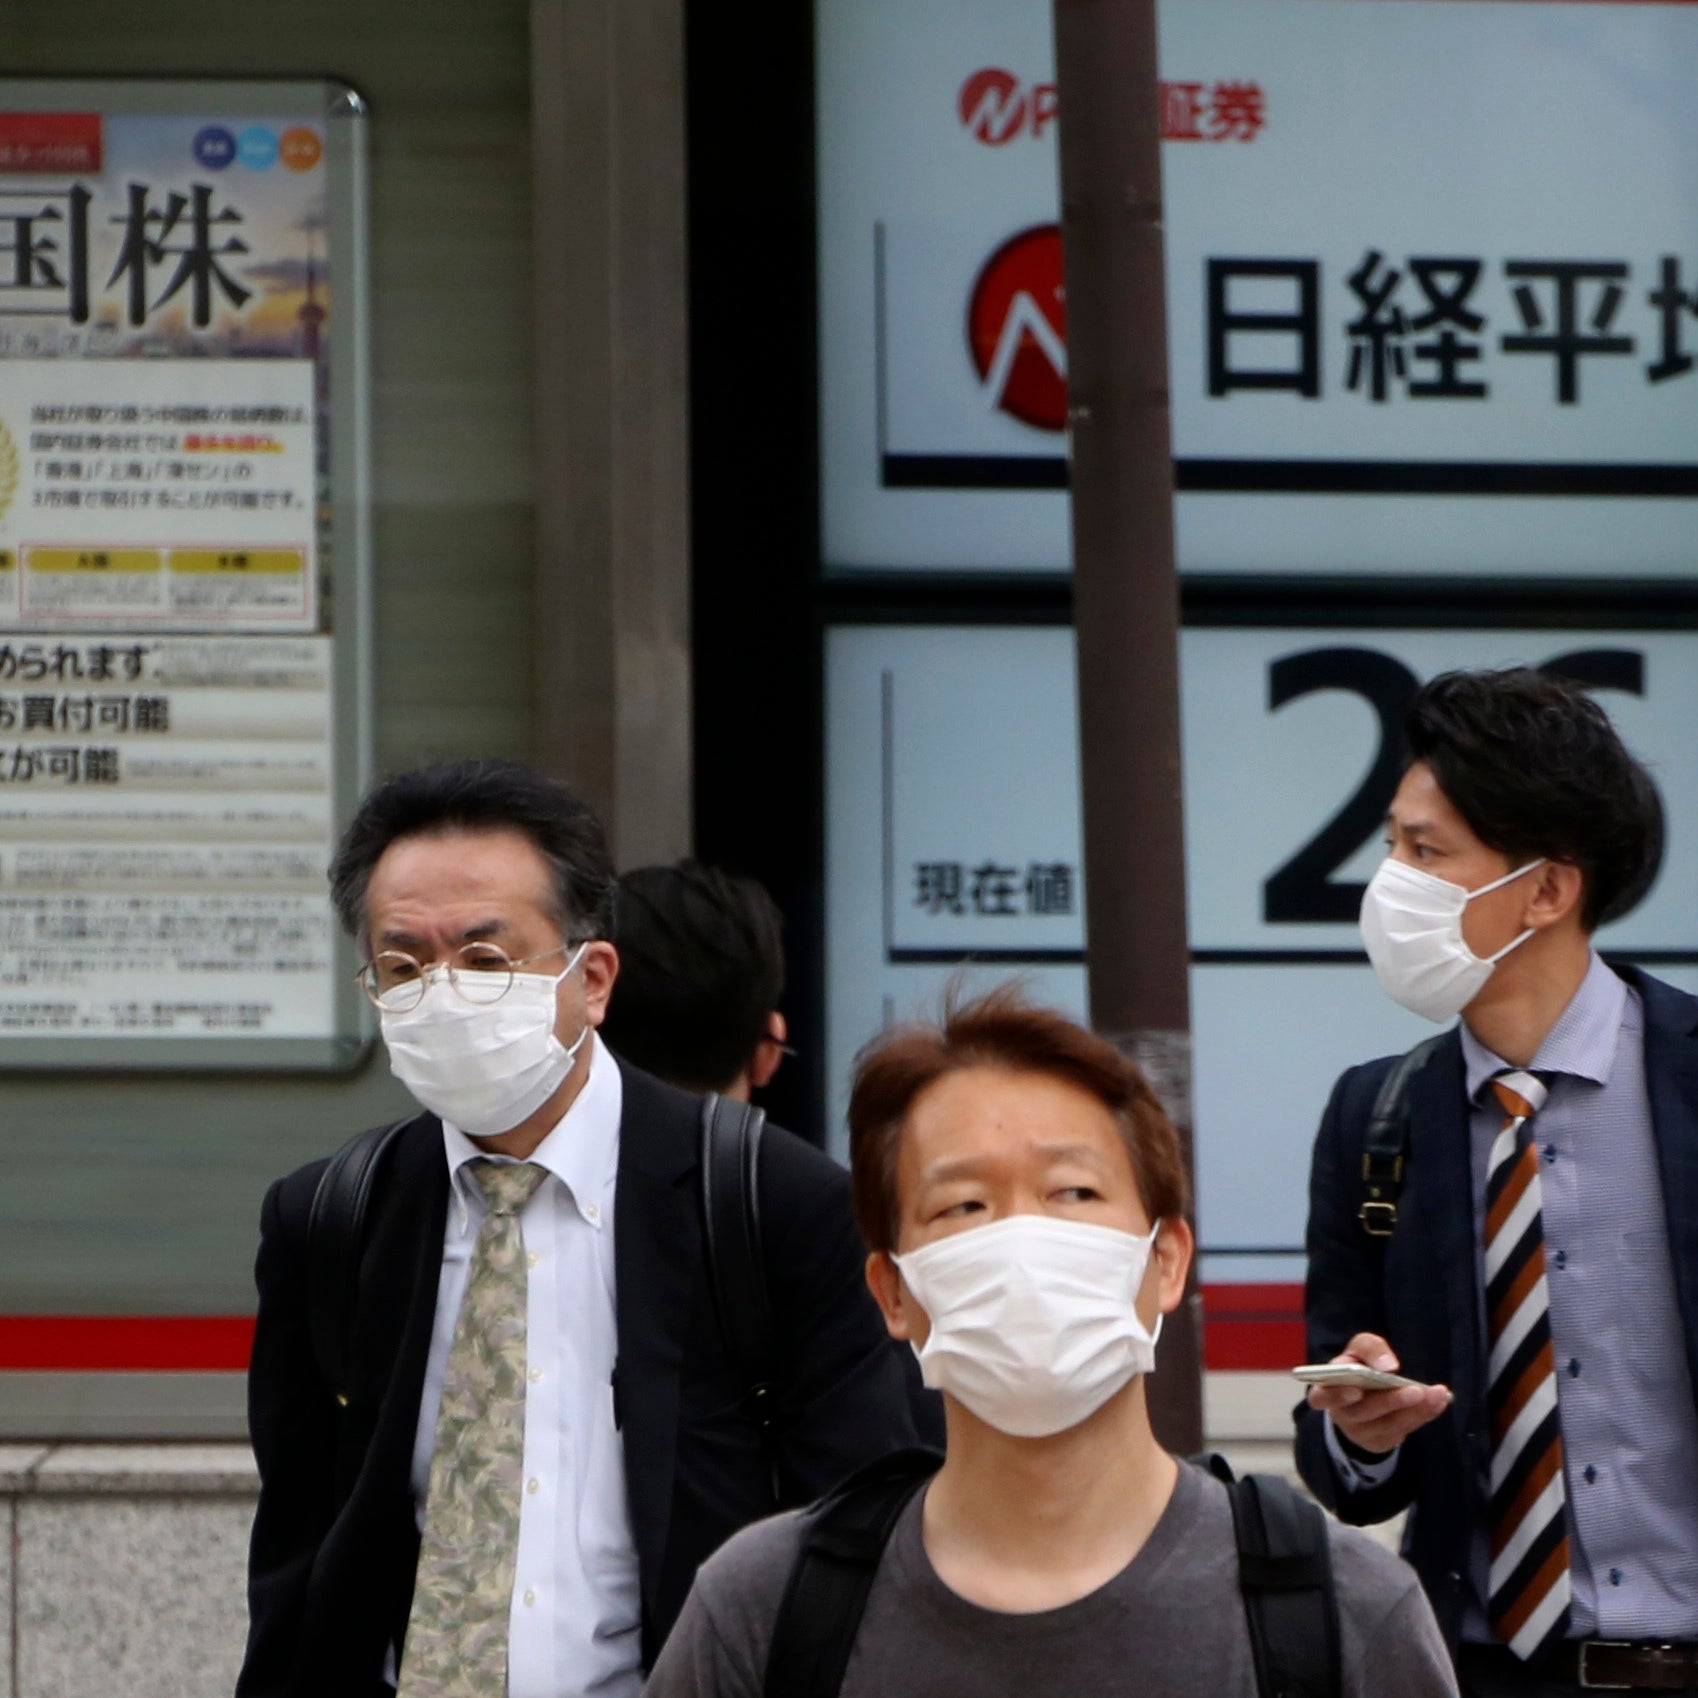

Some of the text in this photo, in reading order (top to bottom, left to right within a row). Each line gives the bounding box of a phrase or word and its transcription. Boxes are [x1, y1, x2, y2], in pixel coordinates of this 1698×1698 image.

[0, 747, 120, 786] が可能
[914, 859, 1072, 917] 現在値
